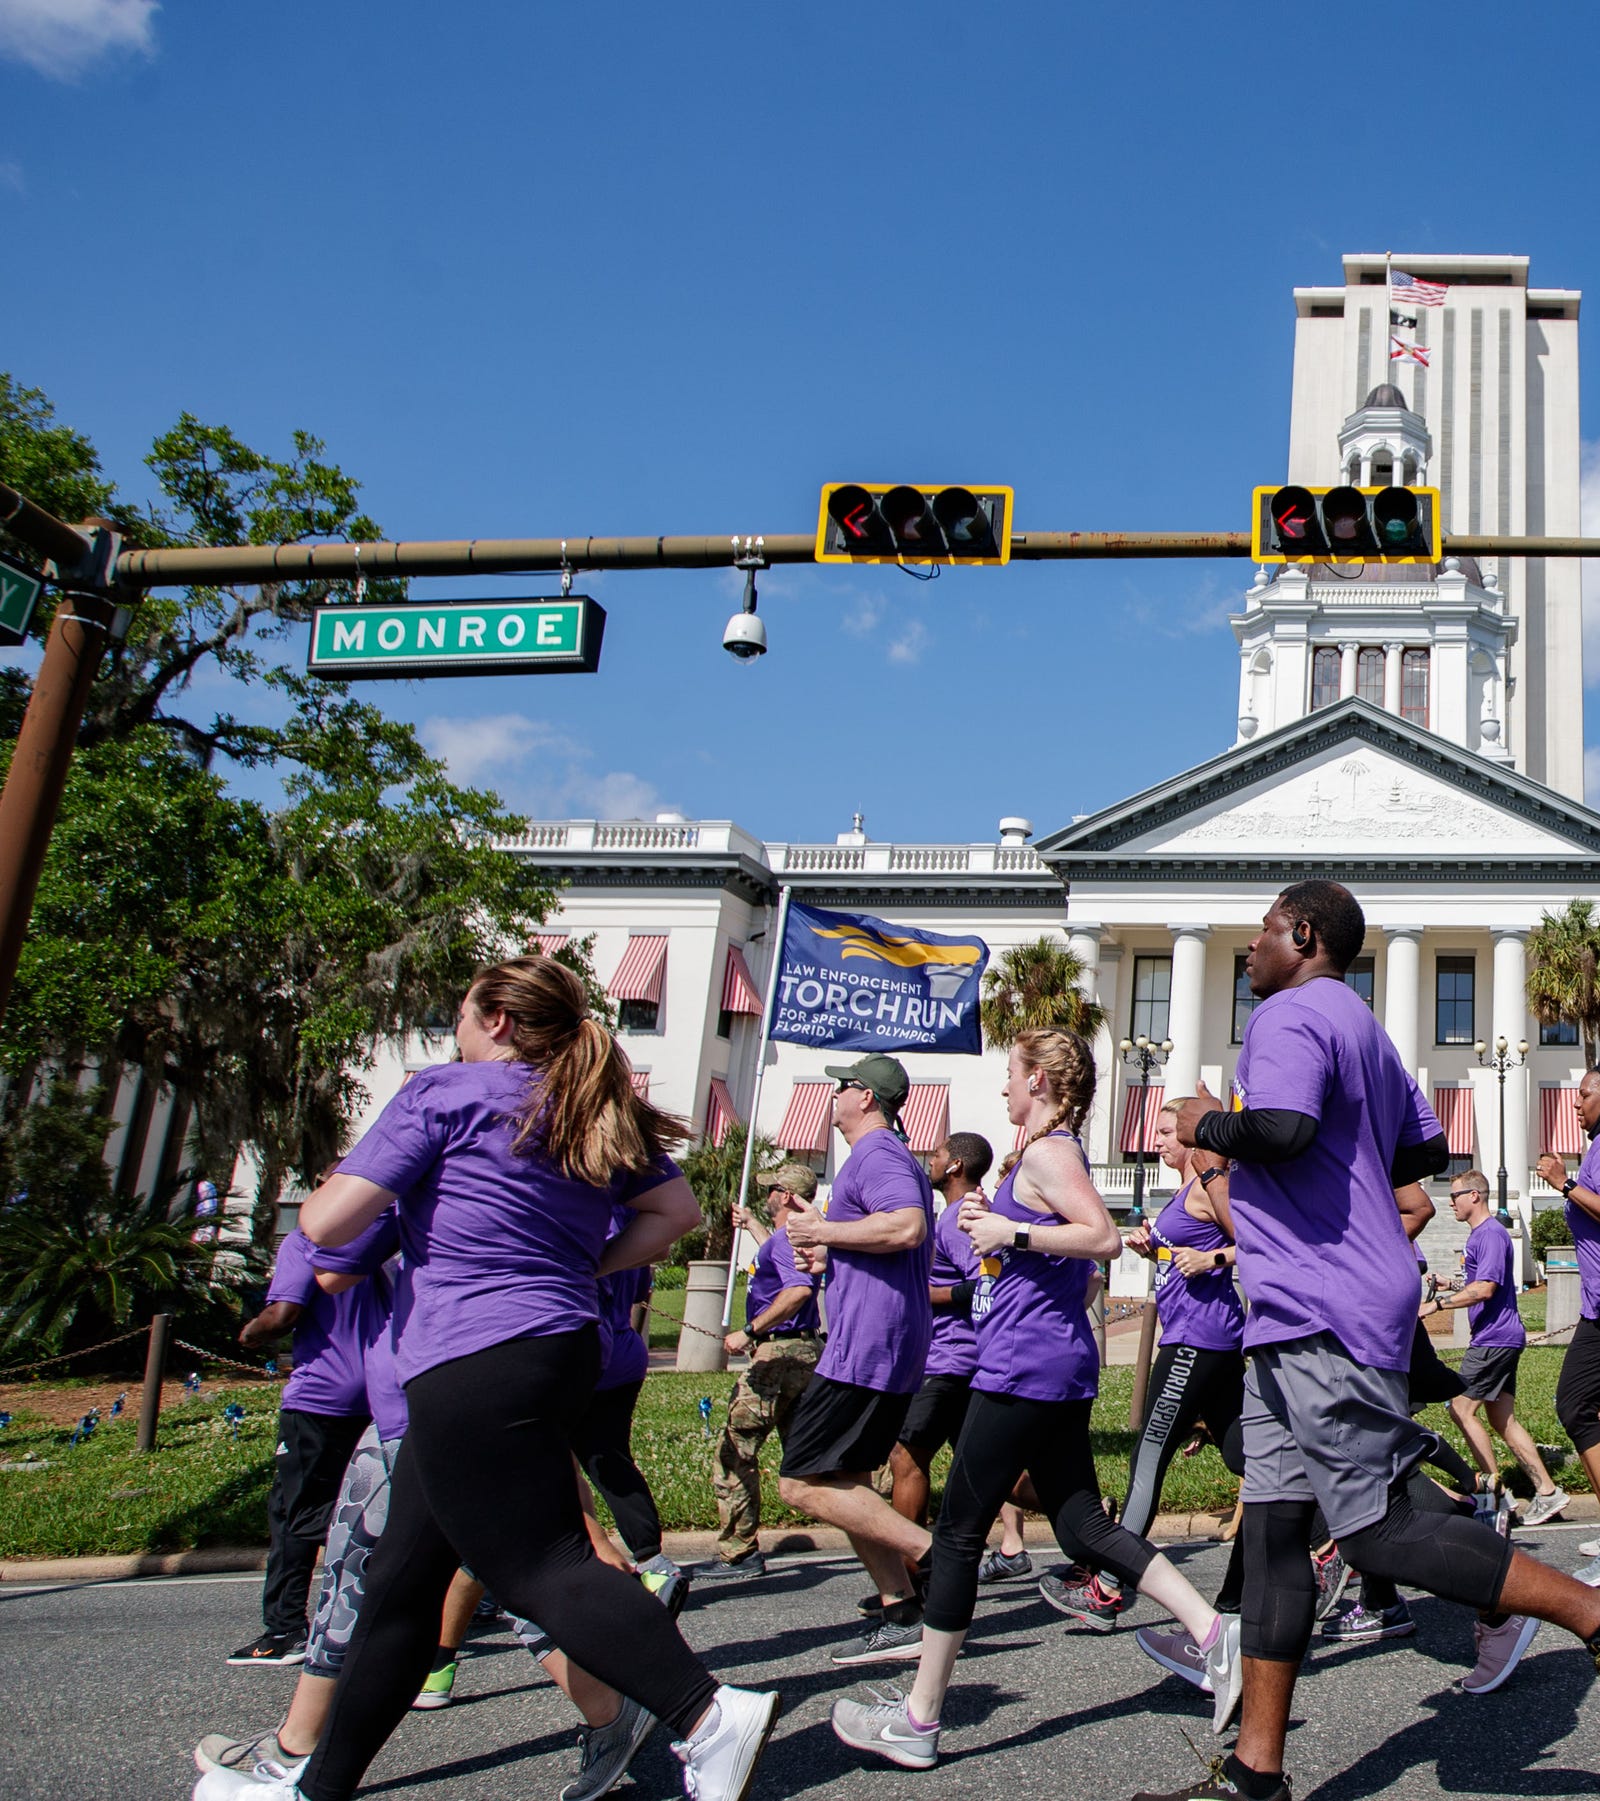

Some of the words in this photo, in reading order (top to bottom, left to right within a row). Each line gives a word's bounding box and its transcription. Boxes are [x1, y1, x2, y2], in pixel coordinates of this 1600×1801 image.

[333, 614, 563, 651] MONROE
[786, 963, 815, 976] LAW
[820, 968, 922, 995] ENFORCEMENT
[775, 1020, 835, 1039] FLORIDA
[780, 1007, 807, 1022] FOR
[811, 1013, 871, 1033] SPECIAL
[876, 1024, 936, 1043] OLYMPICS
[1160, 1346, 1198, 1401] CTORIA
[1144, 1400, 1178, 1448] SPORT
